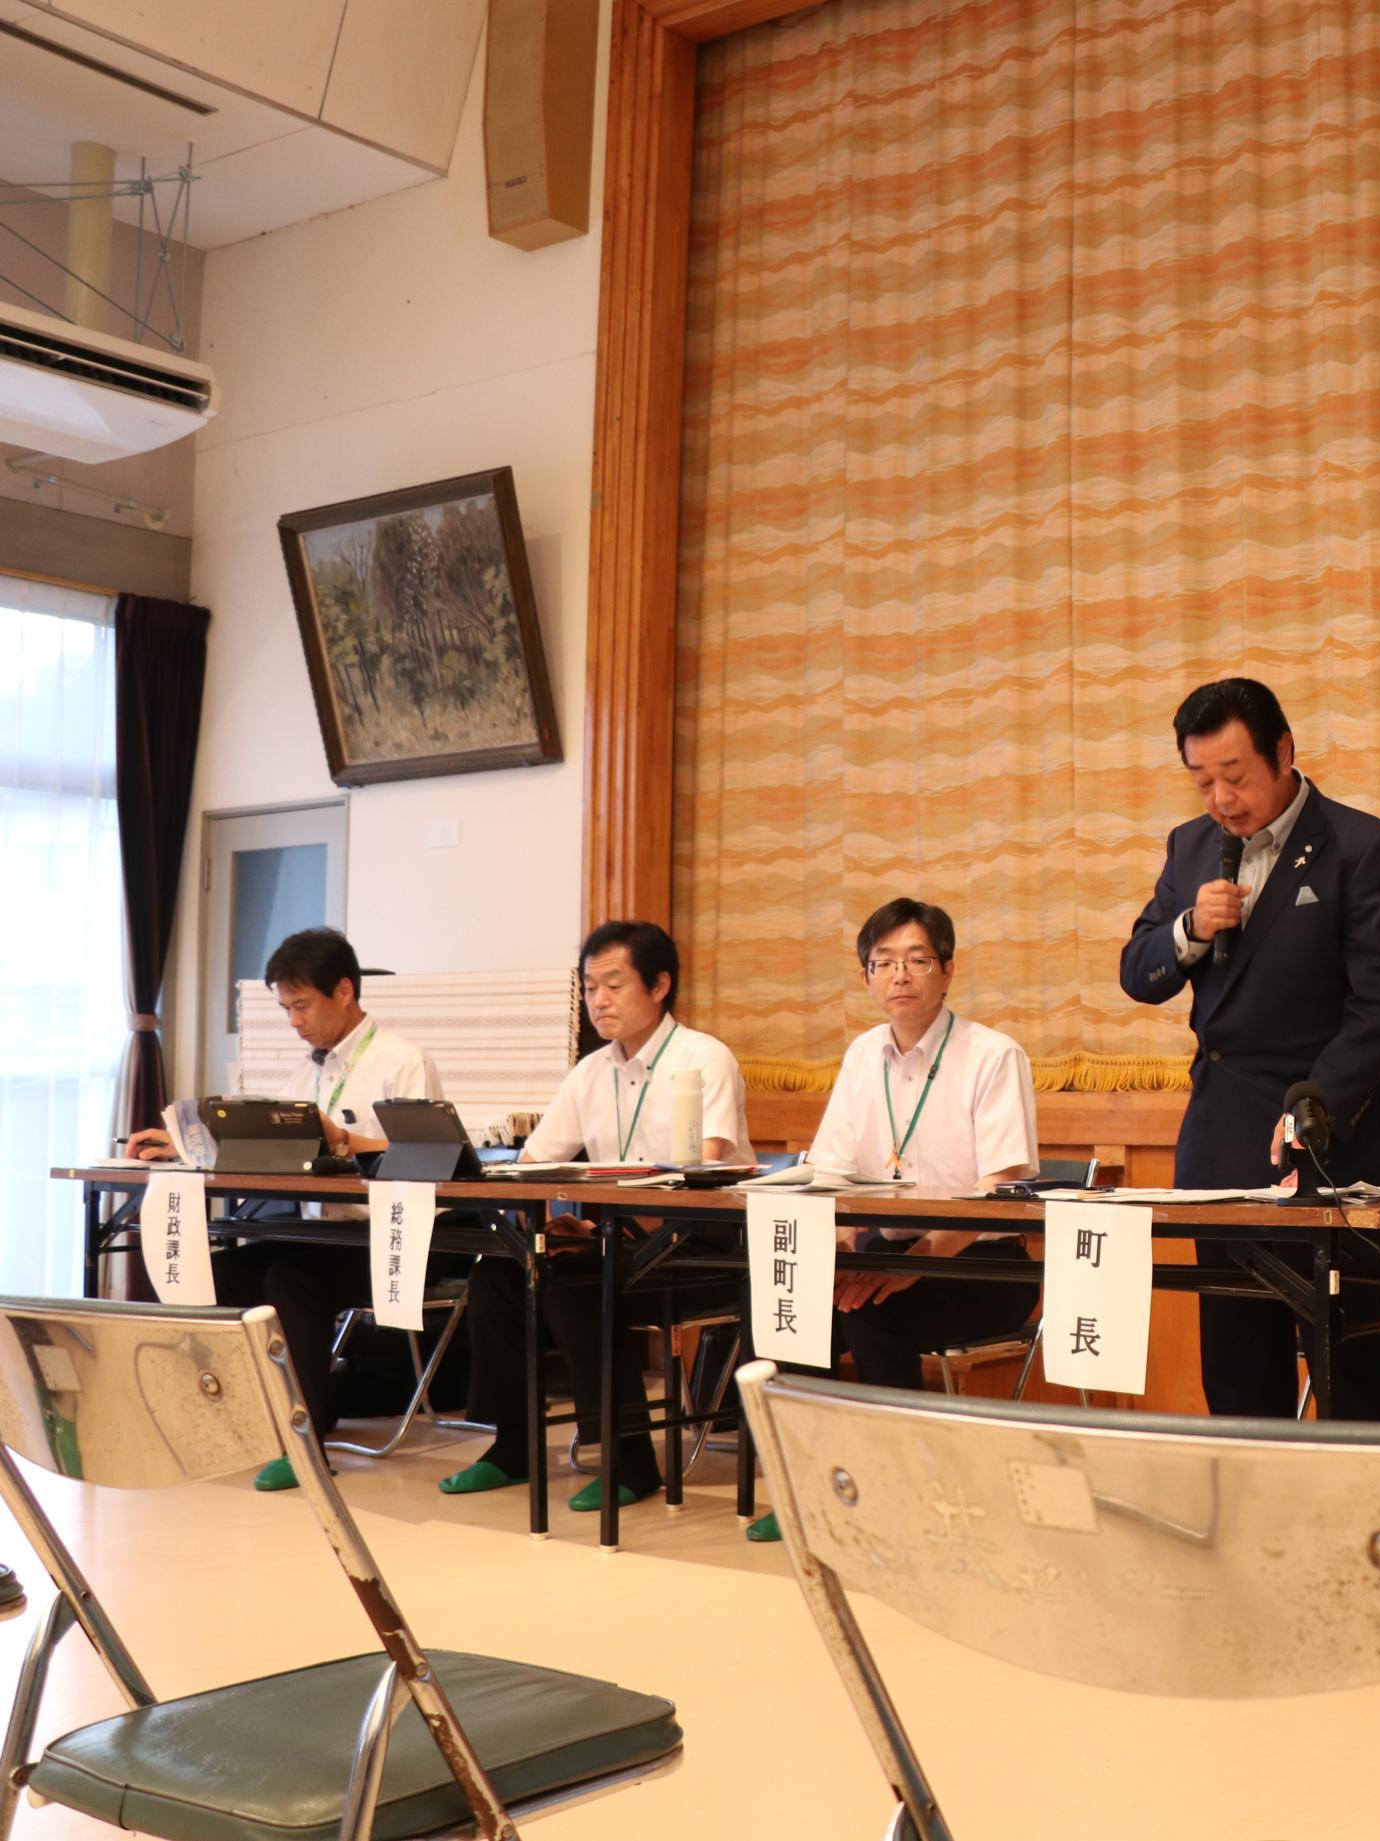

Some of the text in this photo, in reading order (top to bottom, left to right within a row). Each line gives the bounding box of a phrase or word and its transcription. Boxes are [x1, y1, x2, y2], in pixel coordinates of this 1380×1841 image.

[165, 1192, 181, 1285] 財政課長
[388, 1201, 404, 1304] 総務課長
[772, 1218, 798, 1334] 副町長
[1069, 1228, 1109, 1357] 町長
